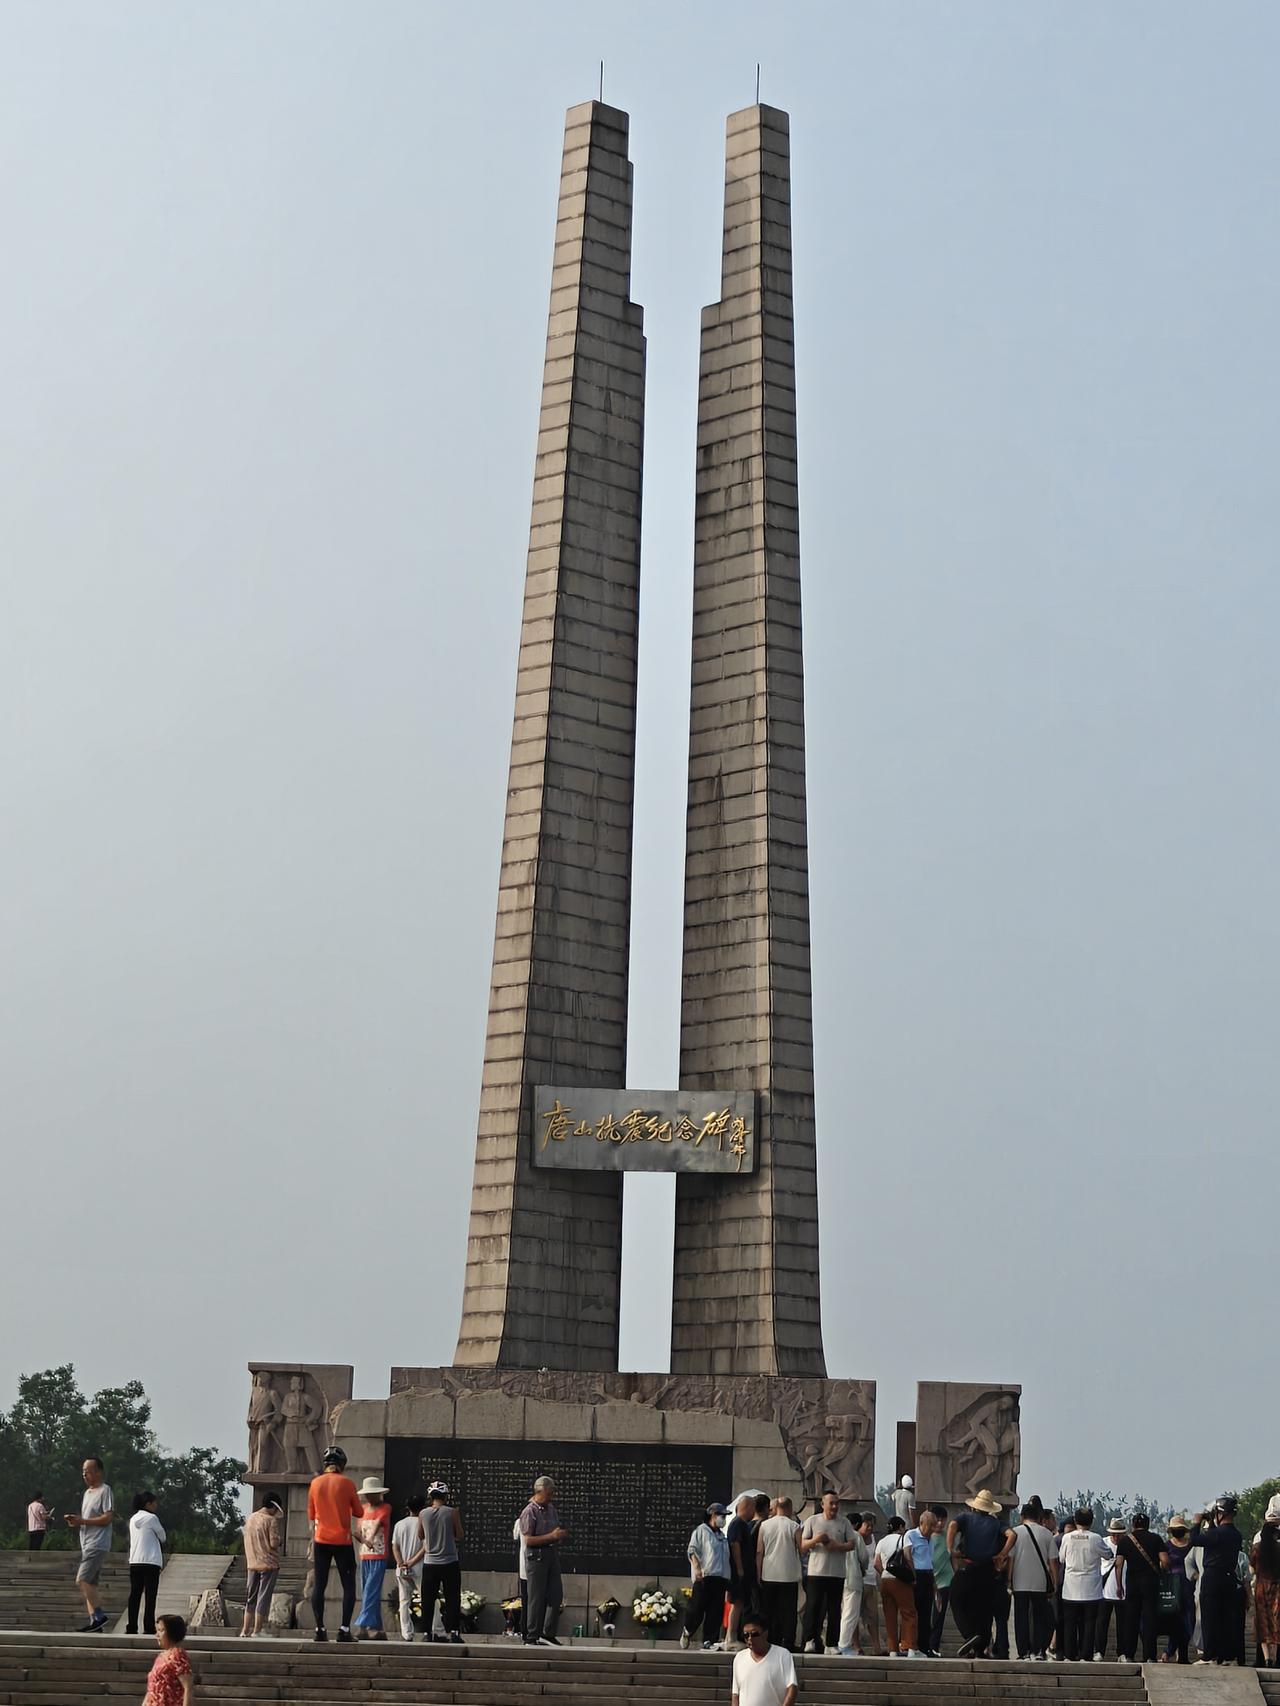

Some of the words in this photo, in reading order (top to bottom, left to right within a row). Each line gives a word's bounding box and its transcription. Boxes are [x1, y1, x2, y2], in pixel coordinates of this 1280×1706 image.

[541, 1099, 731, 1152] 唐山抗震纪念碑
